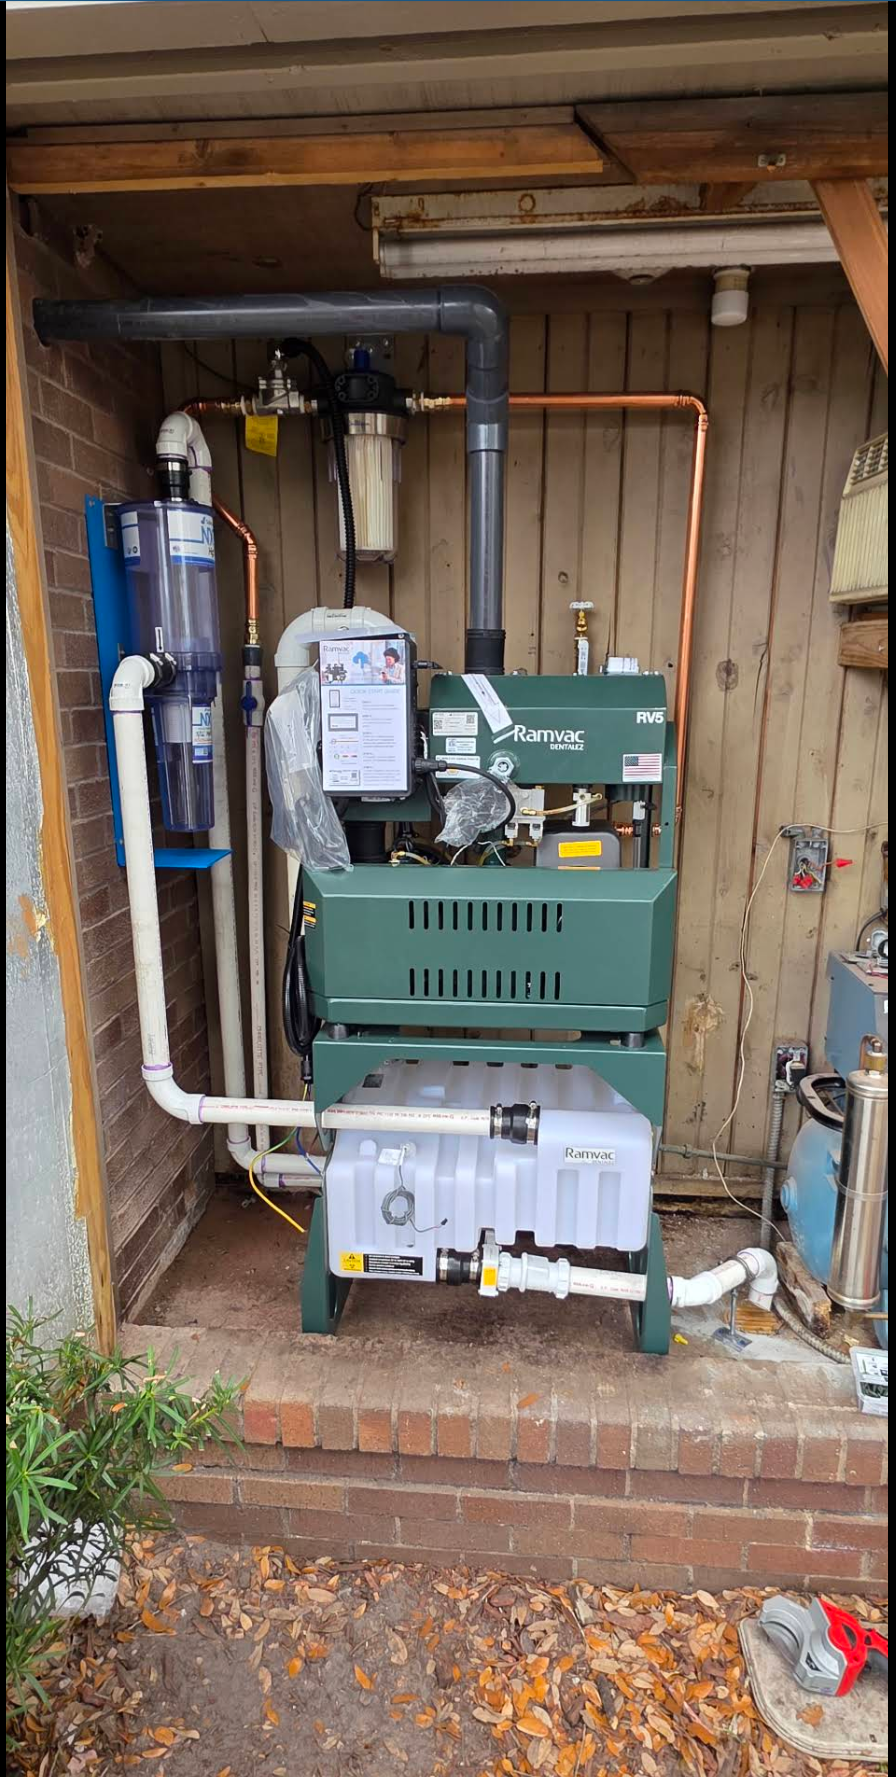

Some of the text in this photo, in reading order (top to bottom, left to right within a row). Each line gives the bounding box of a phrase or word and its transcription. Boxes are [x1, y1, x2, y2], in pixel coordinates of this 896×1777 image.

[636, 711, 664, 724] RV5
[513, 724, 585, 743] Ramvac
[549, 743, 584, 751] DENTALEZ
[565, 1147, 614, 1160] Ramvac
